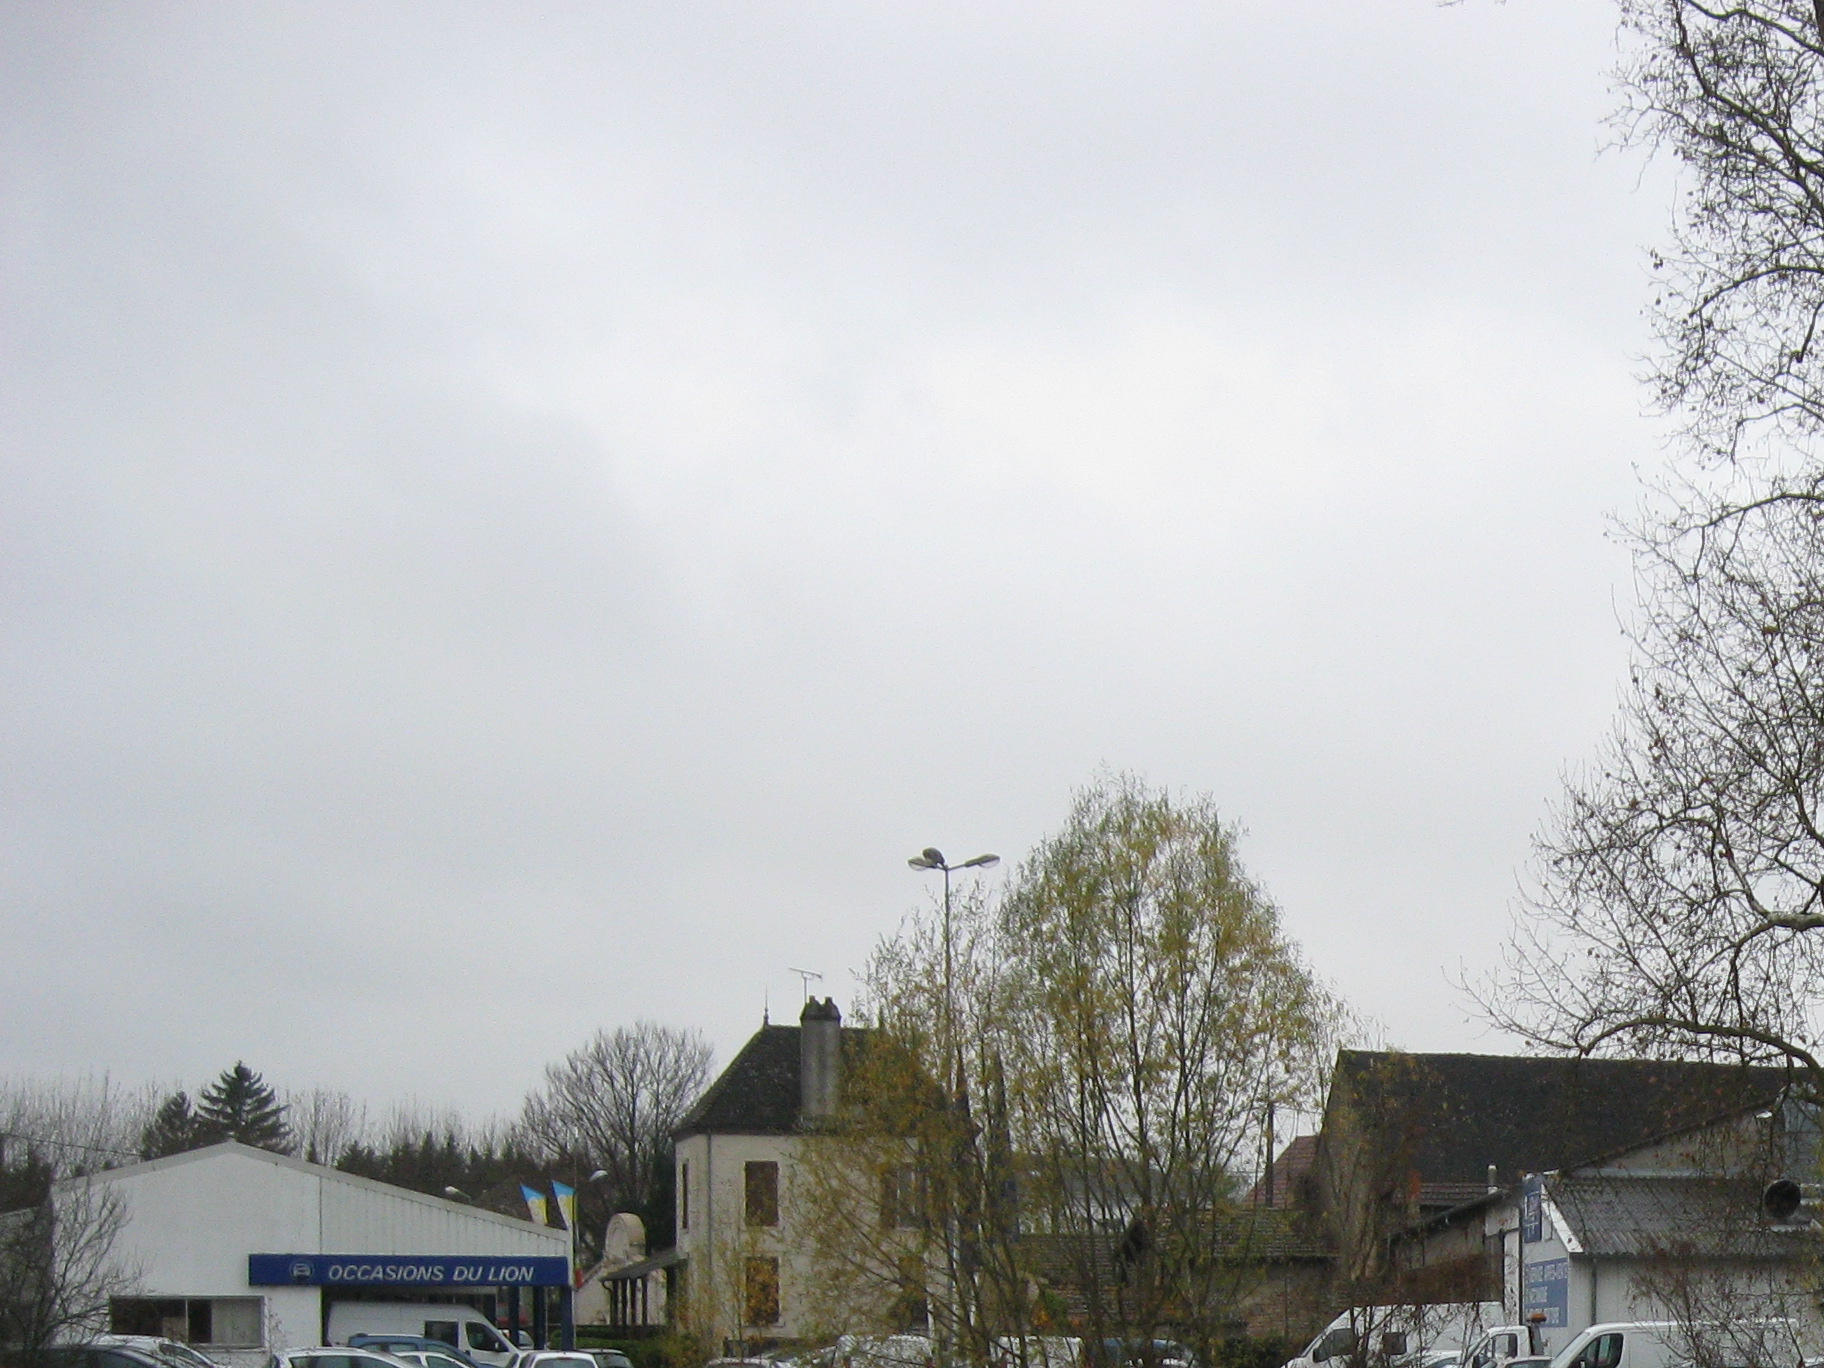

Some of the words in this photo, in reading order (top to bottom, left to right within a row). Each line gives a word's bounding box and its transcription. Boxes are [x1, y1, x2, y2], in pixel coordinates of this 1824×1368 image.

[328, 1264, 445, 1281] OCCASIONS
[452, 1265, 483, 1281] DU
[487, 1266, 534, 1281] LION
